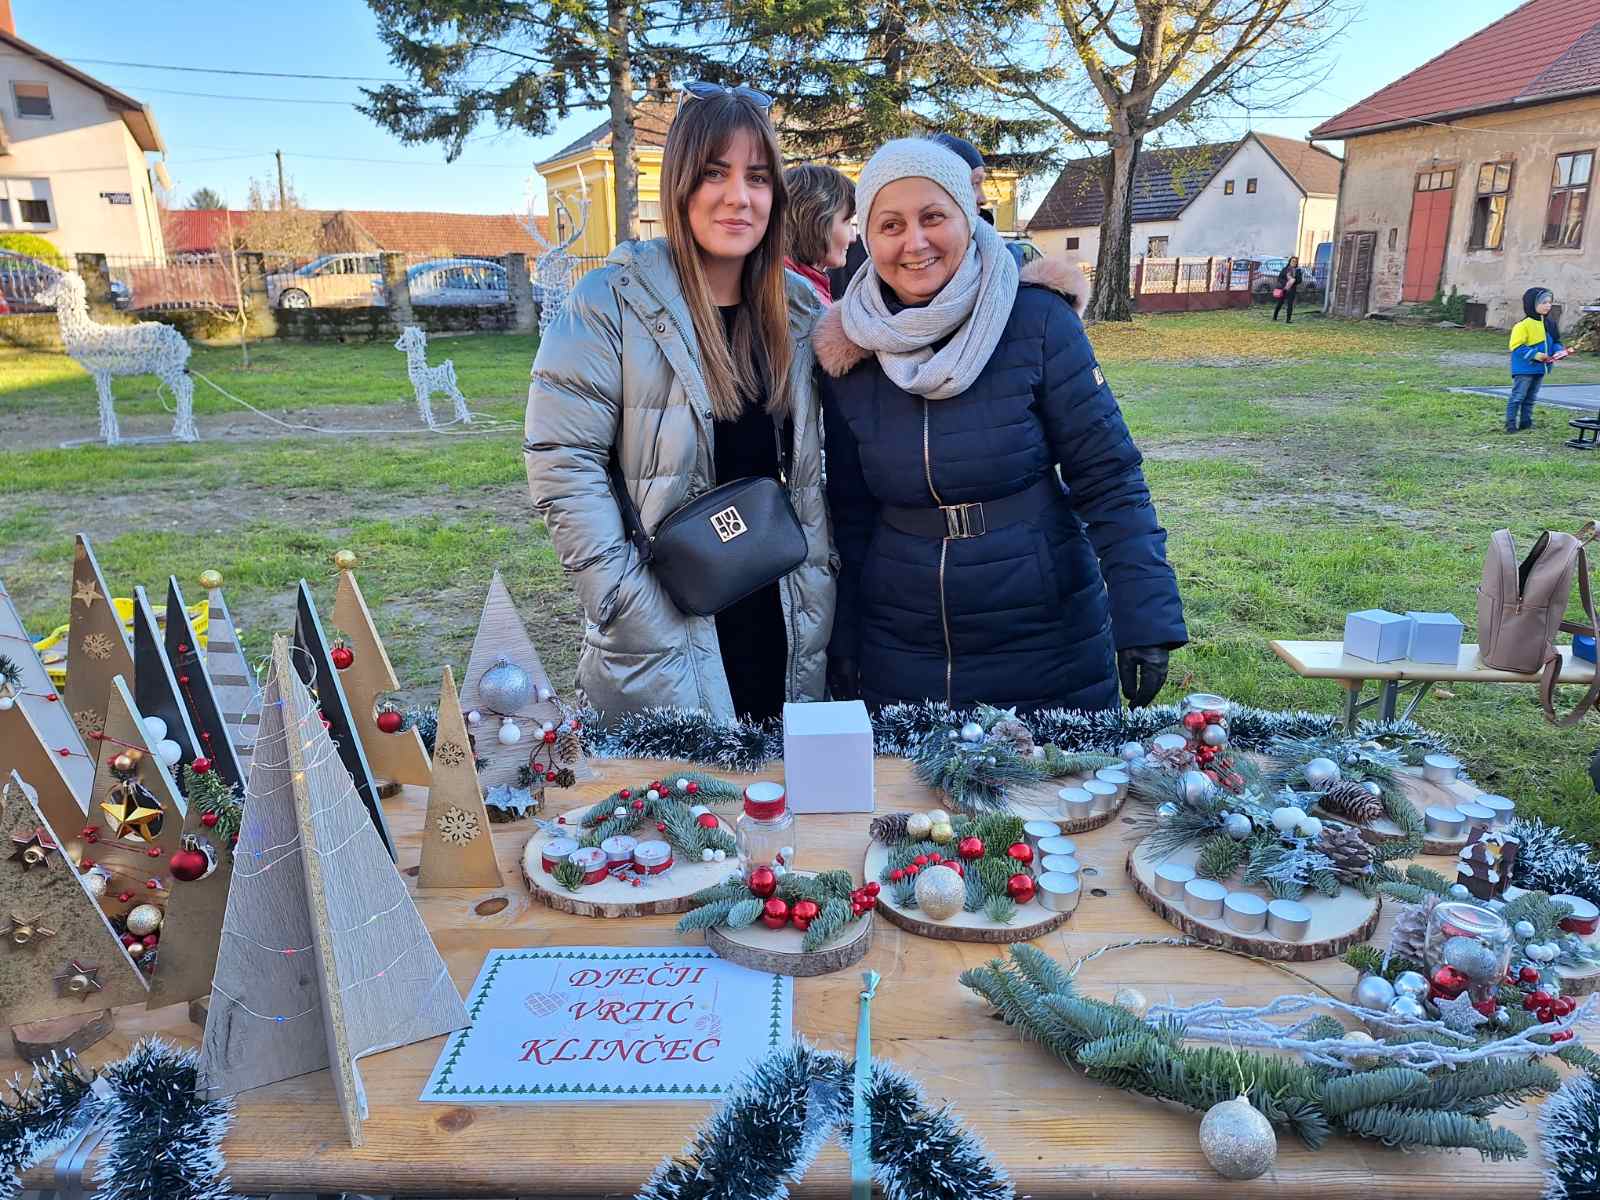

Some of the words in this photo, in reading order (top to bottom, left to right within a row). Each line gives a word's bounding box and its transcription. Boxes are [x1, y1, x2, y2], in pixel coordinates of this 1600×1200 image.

[569, 962, 708, 988] DJEČJI
[568, 994, 694, 1025] VRTIĆ
[518, 1034, 721, 1065] KLINČEC
